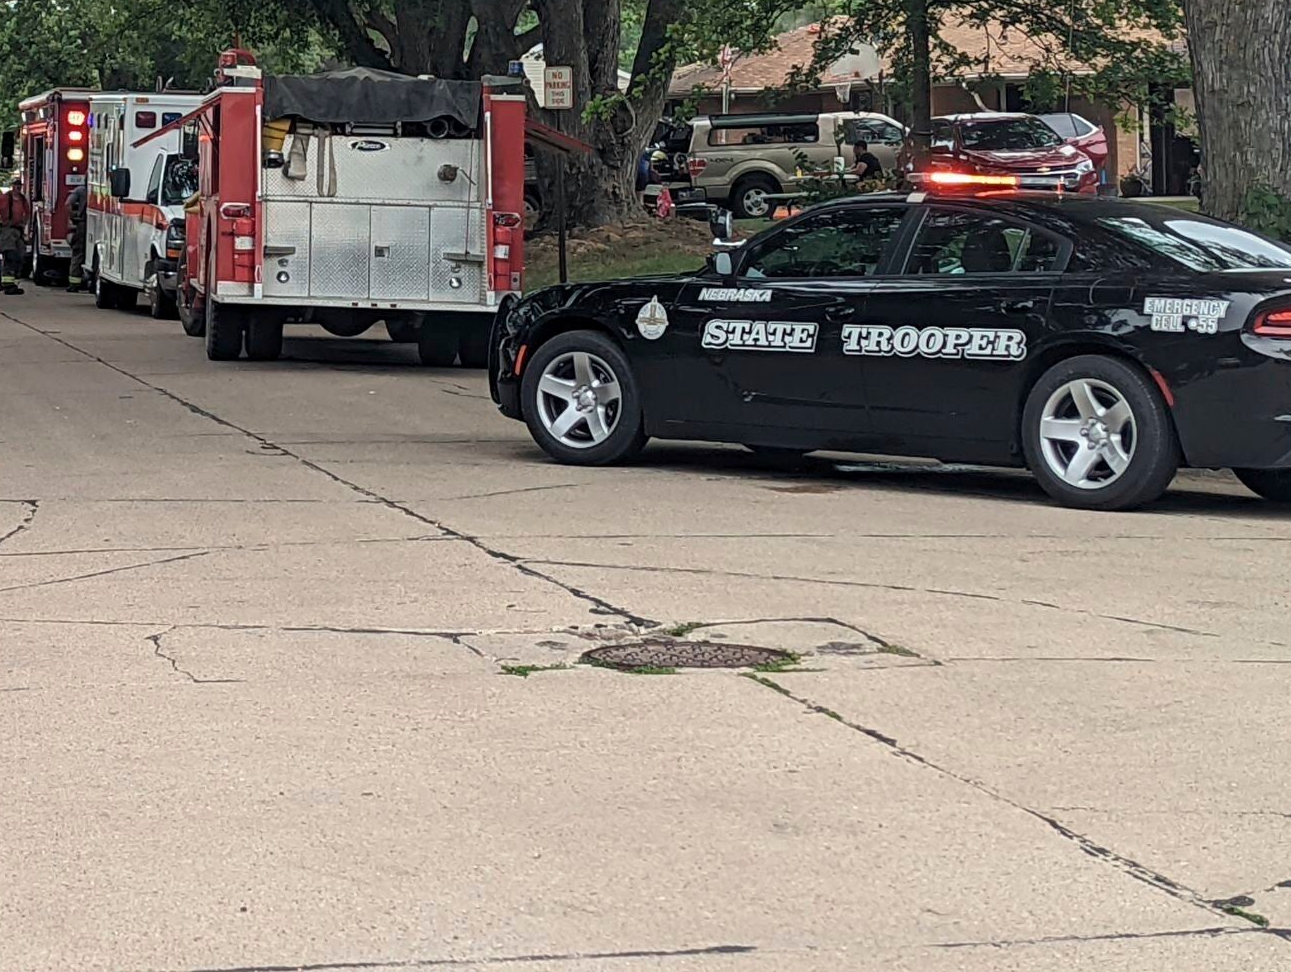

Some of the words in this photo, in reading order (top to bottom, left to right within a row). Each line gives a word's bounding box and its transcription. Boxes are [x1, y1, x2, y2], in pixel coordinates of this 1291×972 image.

[551, 71, 563, 80] NO
[697, 287, 773, 302] NEBRASKA
[1143, 297, 1229, 319] EMERGENCY
[1150, 314, 1186, 332] CELL
[701, 318, 820, 353] STATE
[841, 324, 1027, 362] TROOPER
